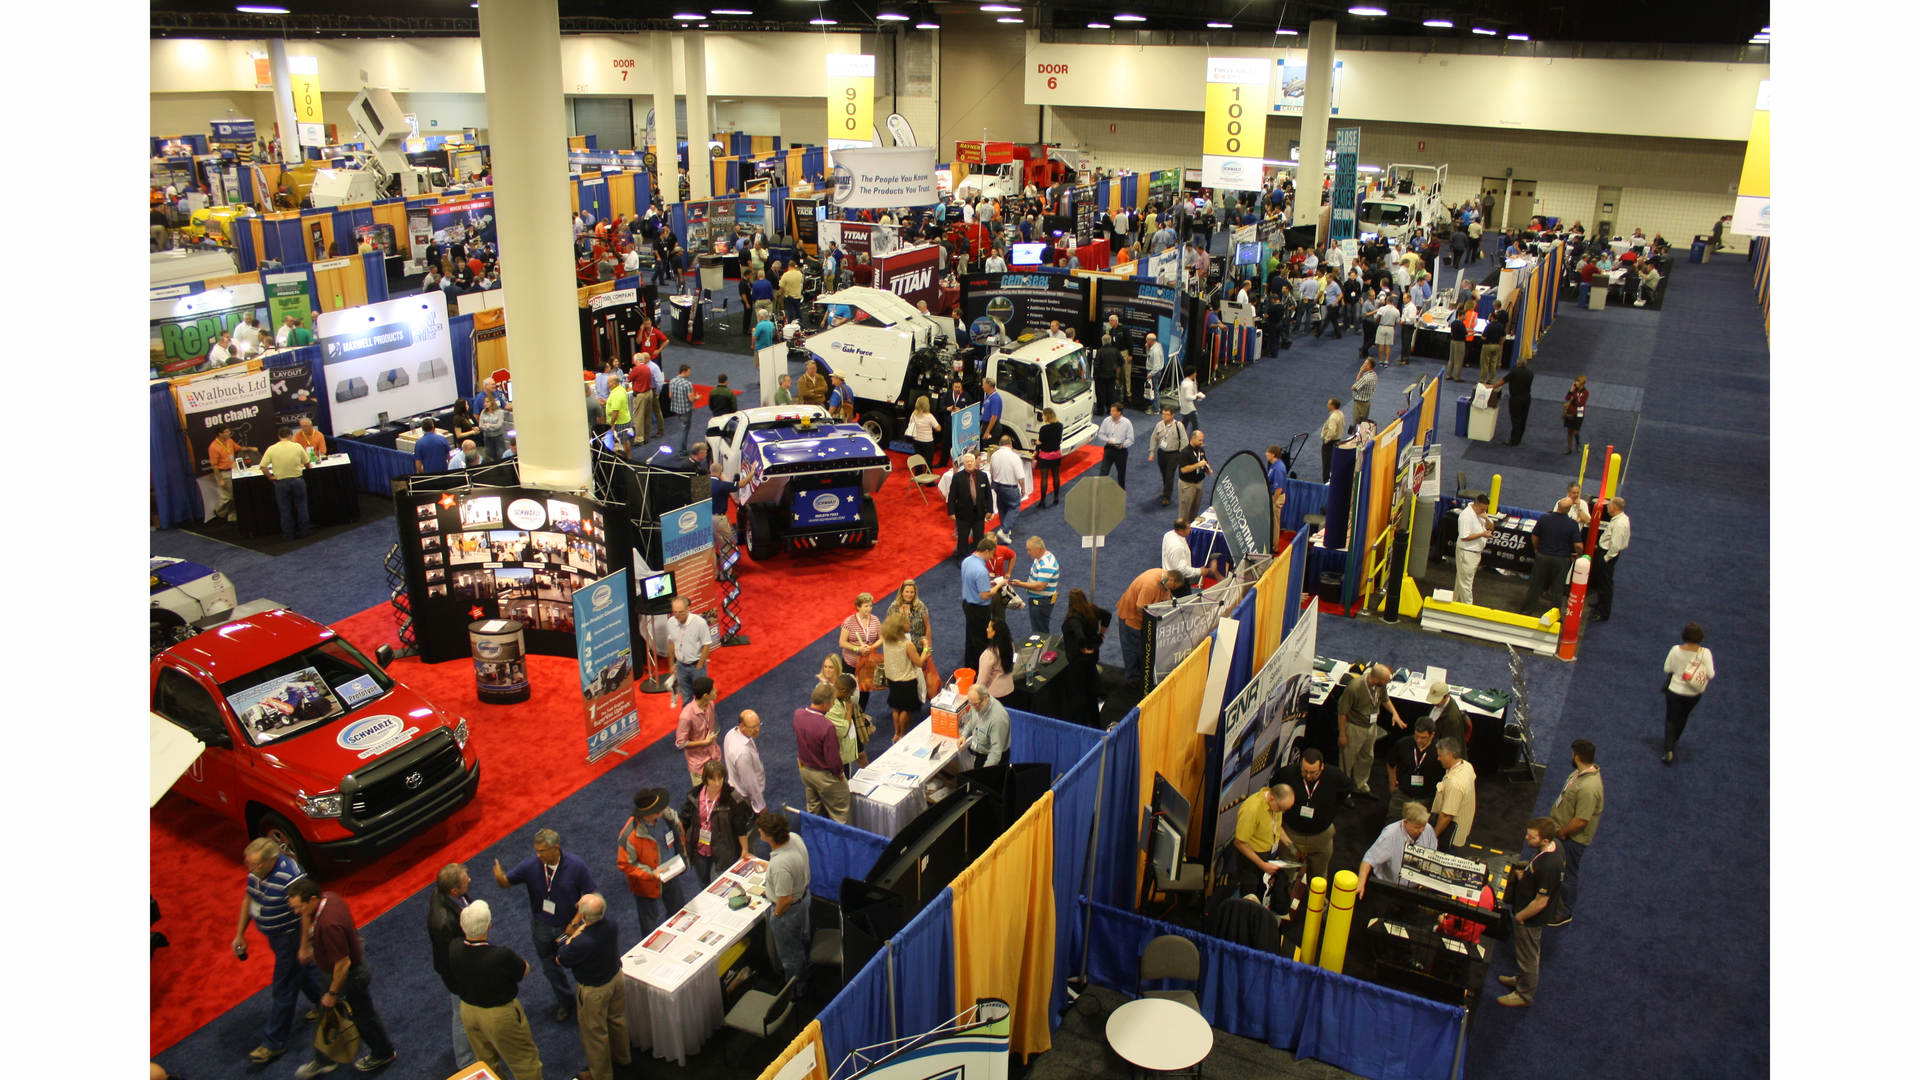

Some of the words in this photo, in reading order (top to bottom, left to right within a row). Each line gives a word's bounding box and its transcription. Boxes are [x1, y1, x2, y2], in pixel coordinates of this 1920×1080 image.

[613, 59, 635, 68] DOOR
[1037, 64, 1069, 74] DOOR
[621, 70, 628, 81] 7
[576, 84, 589, 93] EXIT
[1047, 77, 1058, 90] 6
[845, 87, 857, 131] 900
[1226, 86, 1243, 153] 1000
[1336, 130, 1357, 146] CLOSE
[1335, 154, 1356, 173] FASTER
[861, 174, 873, 183] The
[874, 175, 899, 185] People
[900, 174, 912, 182] You
[1335, 174, 1356, 189] SMARTER
[860, 186, 872, 195] The
[873, 187, 904, 195] Products
[905, 186, 917, 194] You
[1334, 189, 1356, 209] EASIER
[1333, 208, 1343, 220] SEE
[1342, 208, 1355, 220] HOW
[843, 230, 869, 241] TITAN
[1332, 220, 1354, 238] NOW
[890, 266, 935, 296] TITAN
[602, 294, 612, 303] TOOL
[612, 291, 635, 300] COMPANY
[343, 336, 373, 353] MAXWELL
[373, 331, 404, 346] PRODUCTS
[842, 346, 856, 354] Gale
[856, 348, 873, 356] Force
[272, 369, 303, 378] LAYOUT
[192, 383, 245, 402] Walbuck
[248, 377, 268, 393] Ltd
[220, 396, 239, 405] Crayon
[205, 414, 222, 428] got
[224, 405, 259, 423] chalk?
[280, 413, 308, 423] BLOCK
[664, 526, 712, 552] SCHWARZE
[1486, 537, 1527, 551] GROUP
[590, 613, 604, 624] Product
[585, 631, 592, 642] 4
[585, 646, 592, 658] 3
[585, 660, 593, 674] 2
[347, 684, 379, 702] Prototype
[589, 704, 596, 720] 1
[1226, 679, 1260, 735] GNR
[348, 718, 394, 744] SCHWARZE
[1406, 844, 1425, 856] GNR
